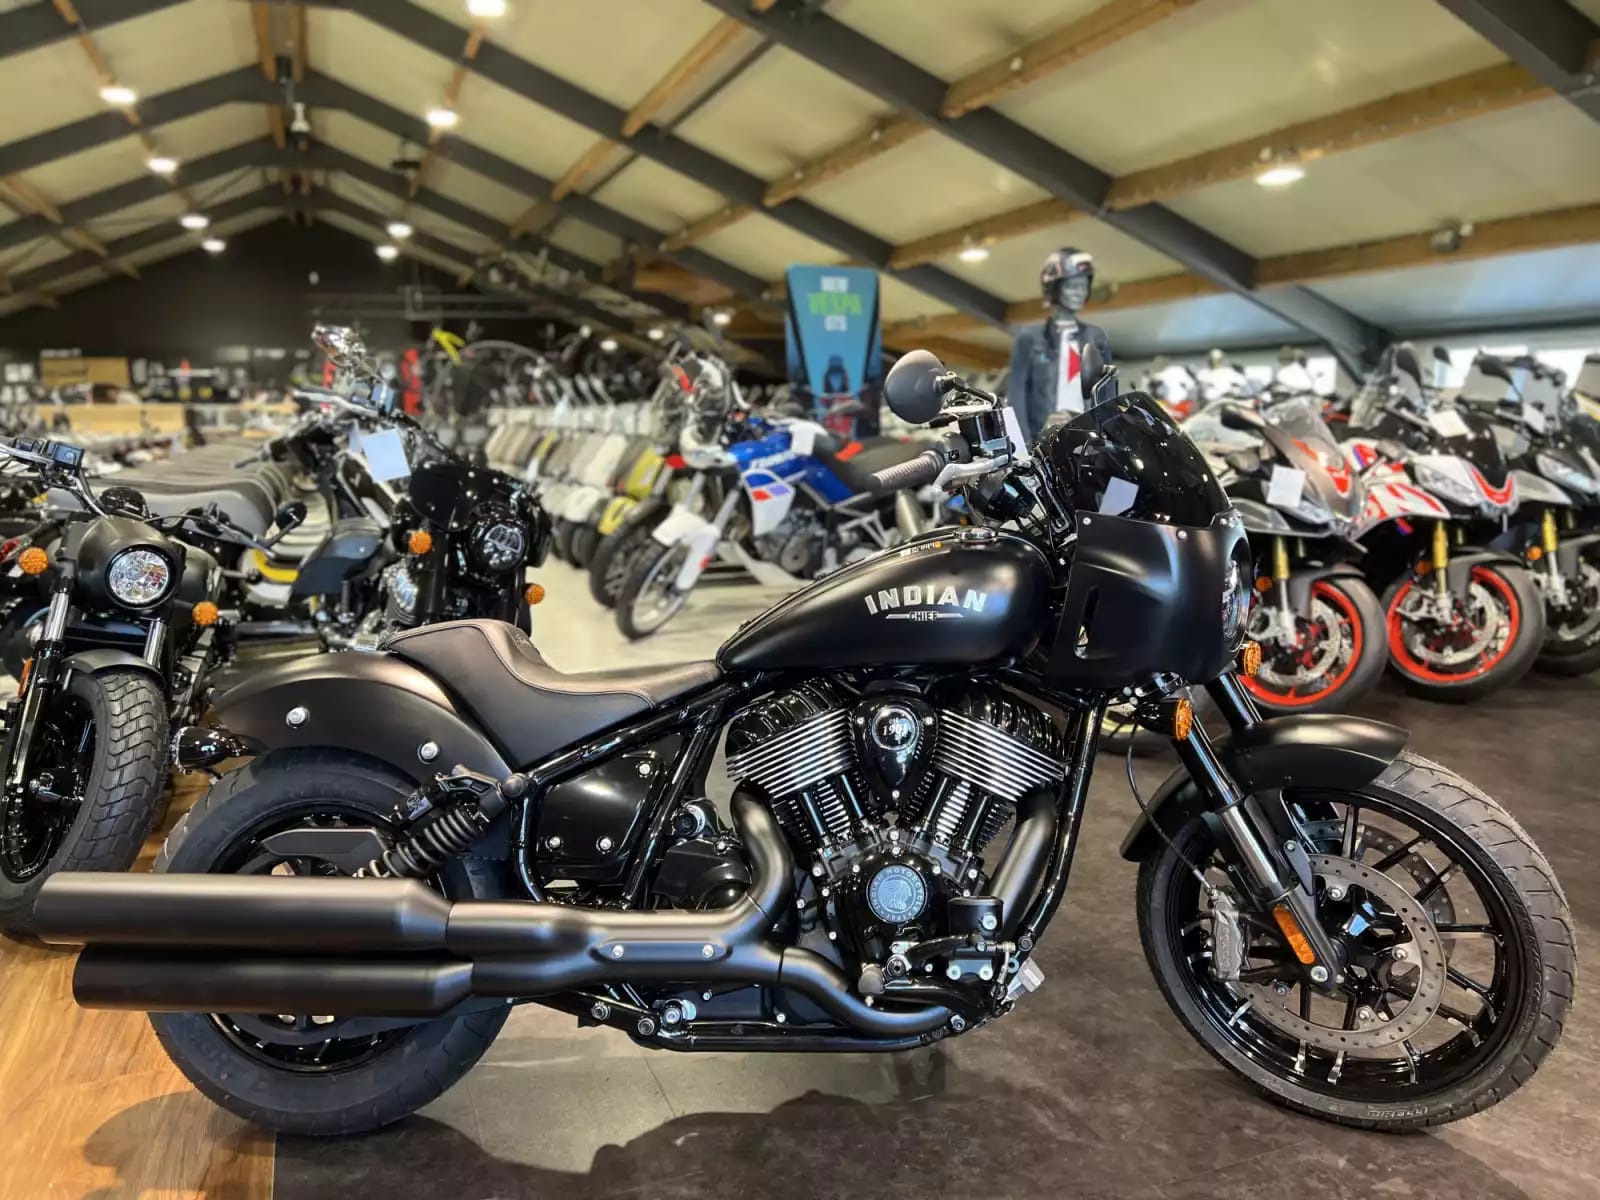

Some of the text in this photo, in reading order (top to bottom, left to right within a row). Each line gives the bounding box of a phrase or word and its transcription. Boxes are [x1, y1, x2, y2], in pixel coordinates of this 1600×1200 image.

[809, 292, 862, 315] VESPA
[864, 586, 987, 615] INDIAN
[909, 611, 939, 622] CHIEF
[887, 868, 923, 914] MOTORCYCLE
